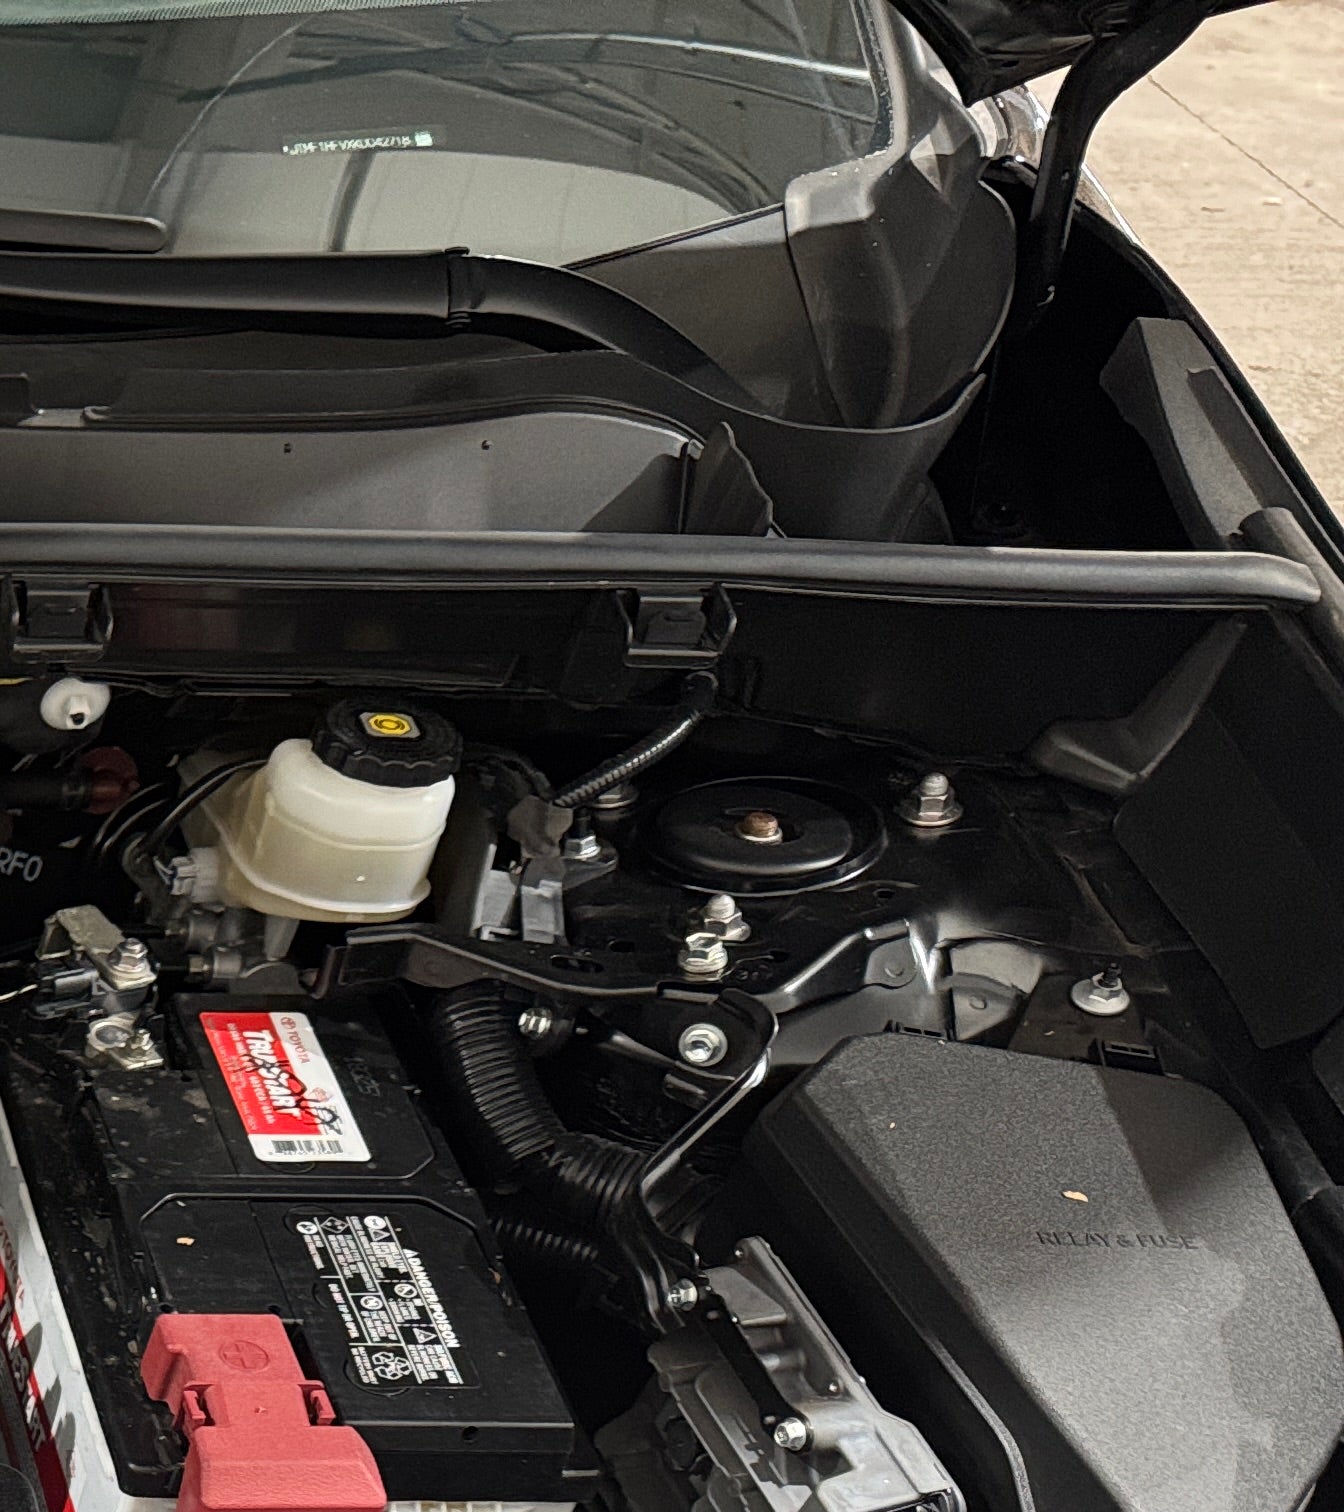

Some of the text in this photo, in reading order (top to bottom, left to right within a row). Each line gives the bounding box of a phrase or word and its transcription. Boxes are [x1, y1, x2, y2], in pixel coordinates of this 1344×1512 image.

[287, 1027, 310, 1064] TOYOTA
[1036, 1232, 1111, 1248] RELAY
[1136, 1234, 1199, 1250] FUSE
[408, 1257, 461, 1348] DANGER/POISON
